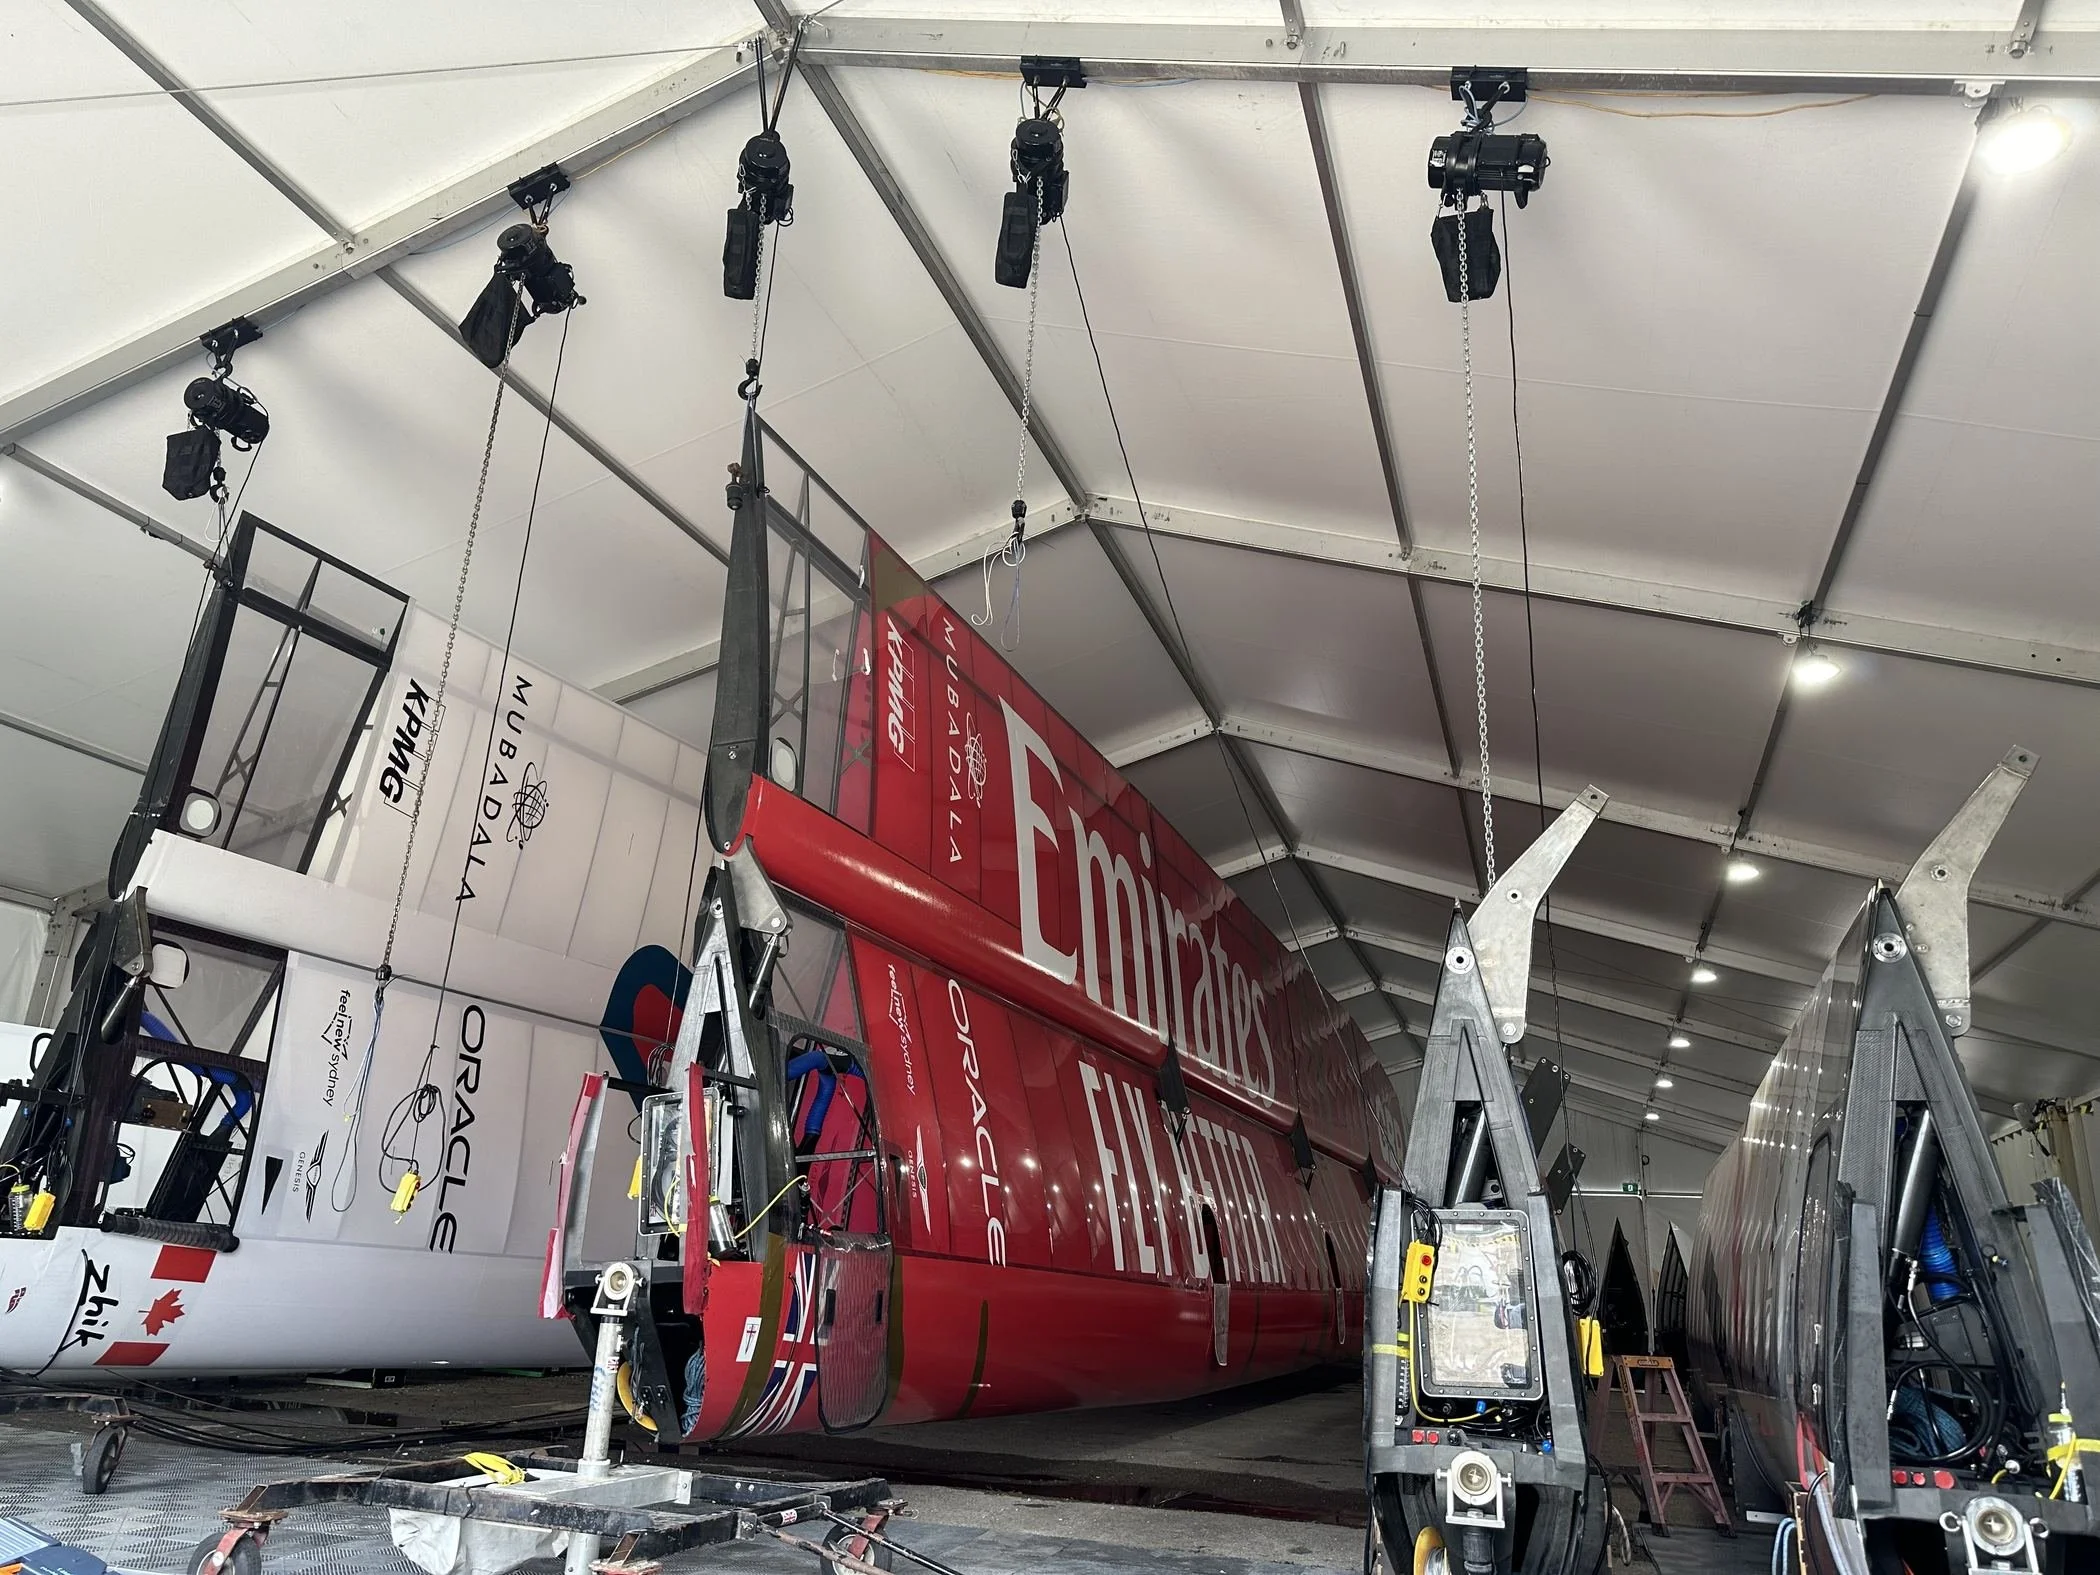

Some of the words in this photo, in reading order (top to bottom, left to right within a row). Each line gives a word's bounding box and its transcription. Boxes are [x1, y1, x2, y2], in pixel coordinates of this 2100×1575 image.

[887, 616, 905, 754] KPMG
[379, 678, 430, 803] KPMG
[943, 617, 963, 862] MUBADALA
[455, 675, 533, 901] MUBADALA
[998, 695, 1276, 1107] Emirates
[338, 989, 351, 1018] feel
[888, 964, 902, 997] feel
[894, 996, 905, 1034] new
[322, 1053, 341, 1107] sydney
[333, 1019, 345, 1052] new
[900, 1035, 916, 1096] sydney
[429, 1004, 485, 1255] ORACLE
[948, 979, 1006, 1268] ORACLE
[1078, 1060, 1173, 1276] FLY
[292, 1151, 306, 1193] GENESIS
[907, 1149, 917, 1198] GENESIS
